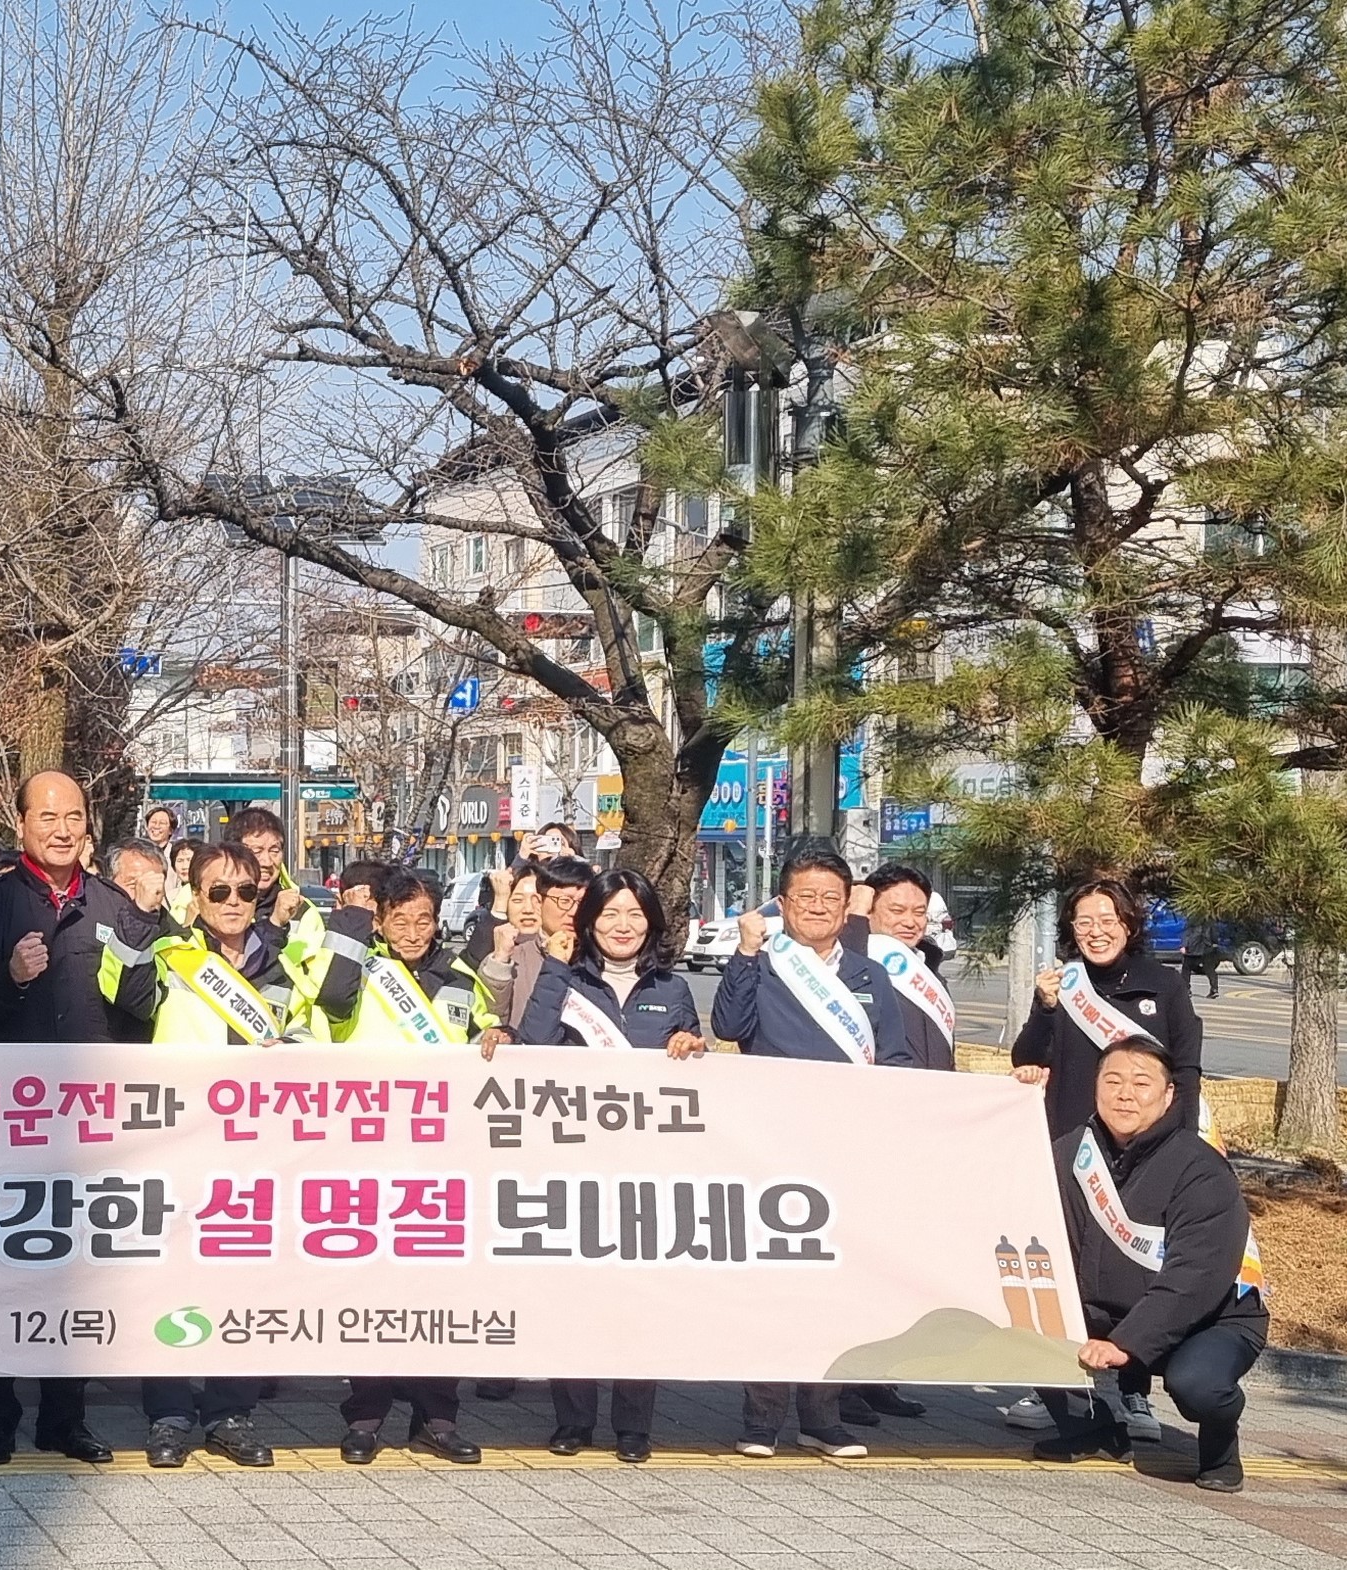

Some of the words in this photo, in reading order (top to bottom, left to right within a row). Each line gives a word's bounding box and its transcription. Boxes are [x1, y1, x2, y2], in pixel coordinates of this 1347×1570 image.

[458, 801, 488, 825] ORLD
[517, 777, 531, 817] 스시준
[200, 967, 232, 999] 작은
[229, 992, 268, 1034] 실천이
[380, 970, 417, 1014] 실천이
[207, 1079, 450, 1143] 안전점검
[473, 1077, 706, 1149] 실천하고
[195, 1179, 274, 1258] 설
[301, 1178, 466, 1259] 명절
[492, 1179, 836, 1263] 보내세요
[12, 1308, 118, 1348] 12.(목)
[219, 1307, 325, 1345] 상주시
[338, 1307, 518, 1346] 안전재난실
